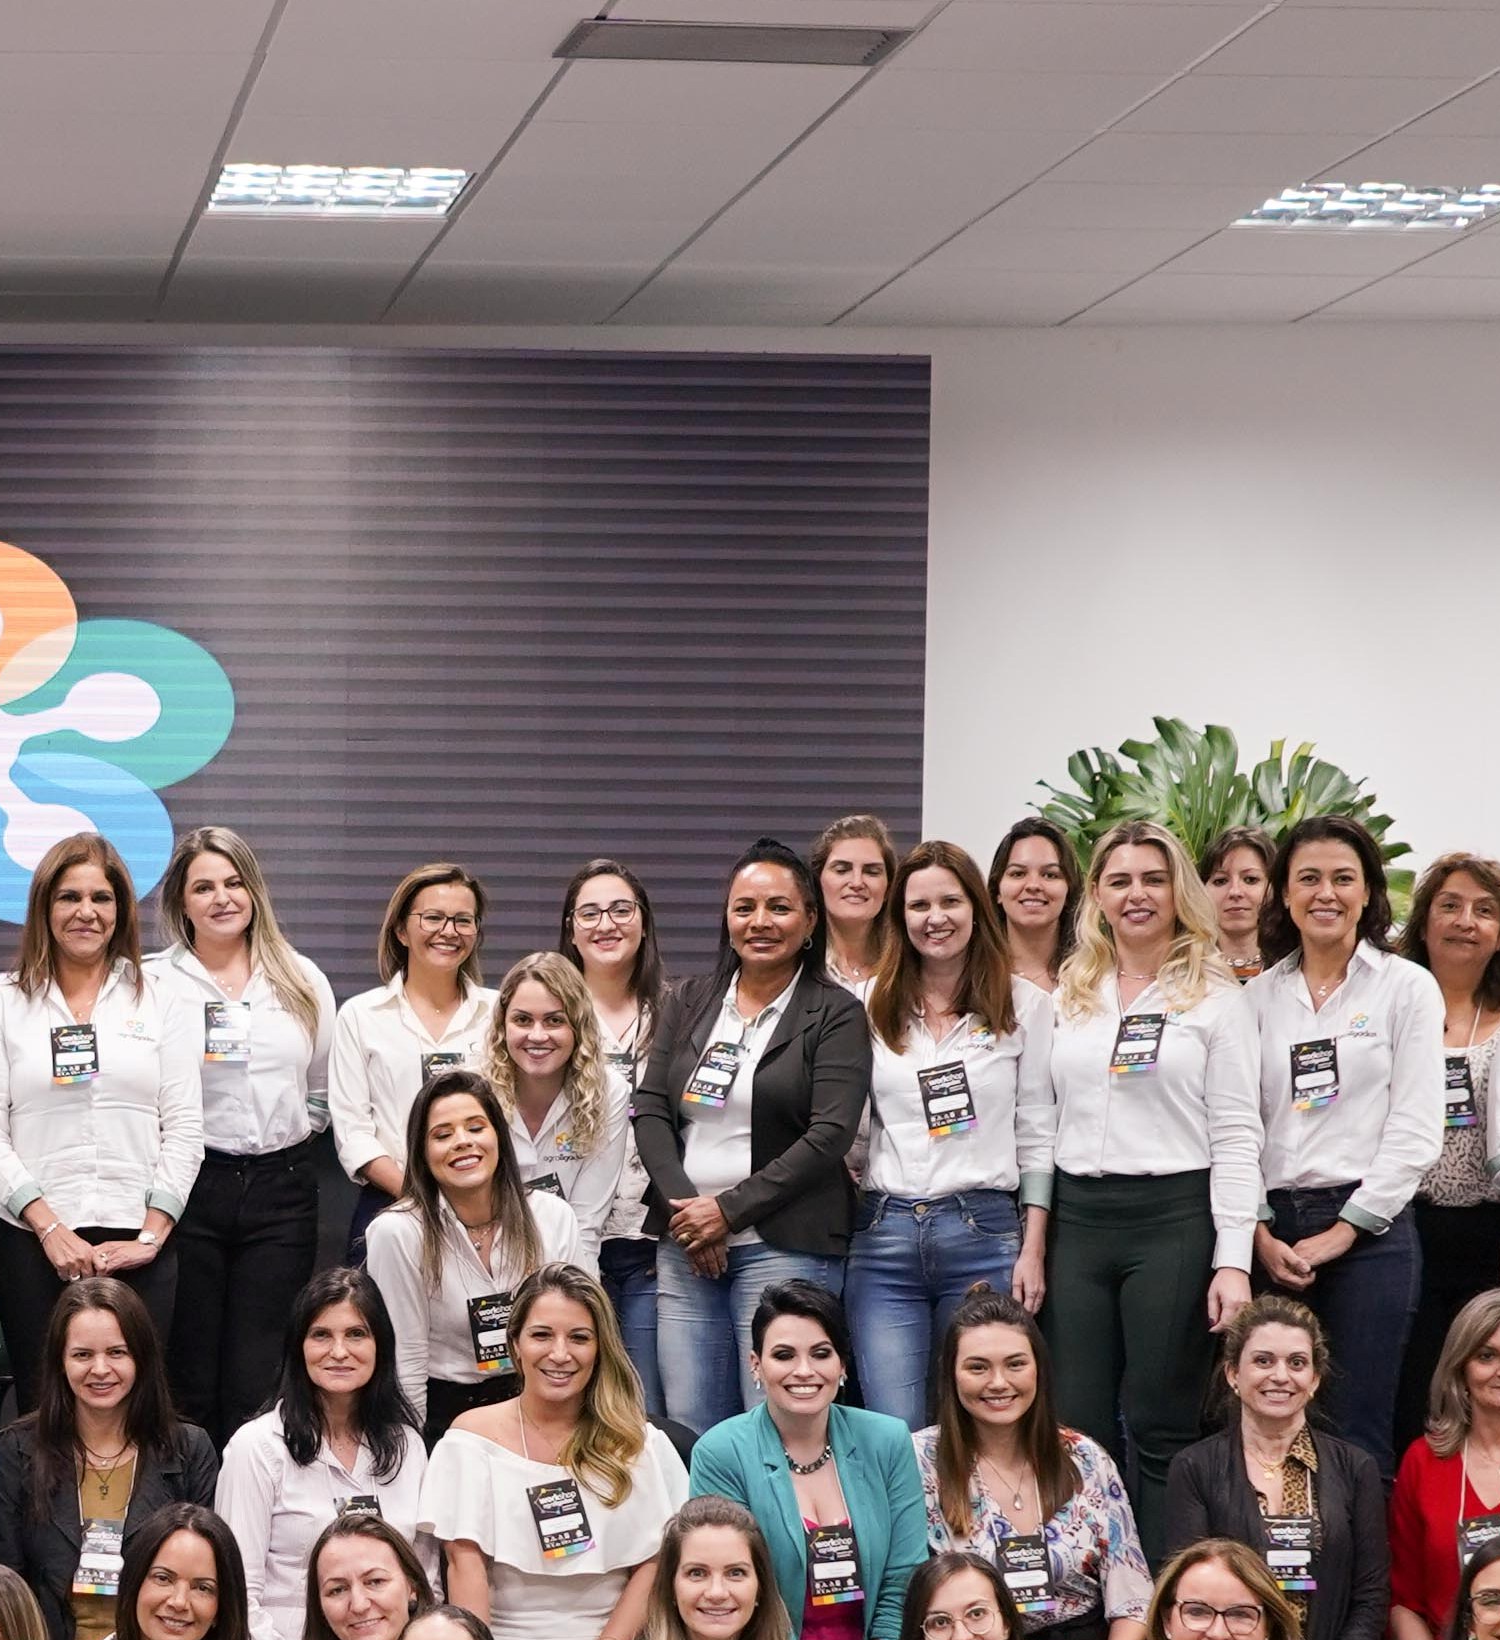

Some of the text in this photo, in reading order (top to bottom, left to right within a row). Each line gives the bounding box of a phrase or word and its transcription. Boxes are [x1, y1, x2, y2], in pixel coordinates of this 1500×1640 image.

[927, 1073, 963, 1086] workshop
[539, 1491, 576, 1504] workshop
[1271, 1526, 1310, 1535] workshop
[815, 1537, 853, 1549] workshop
[1006, 1548, 1045, 1558] workshop
